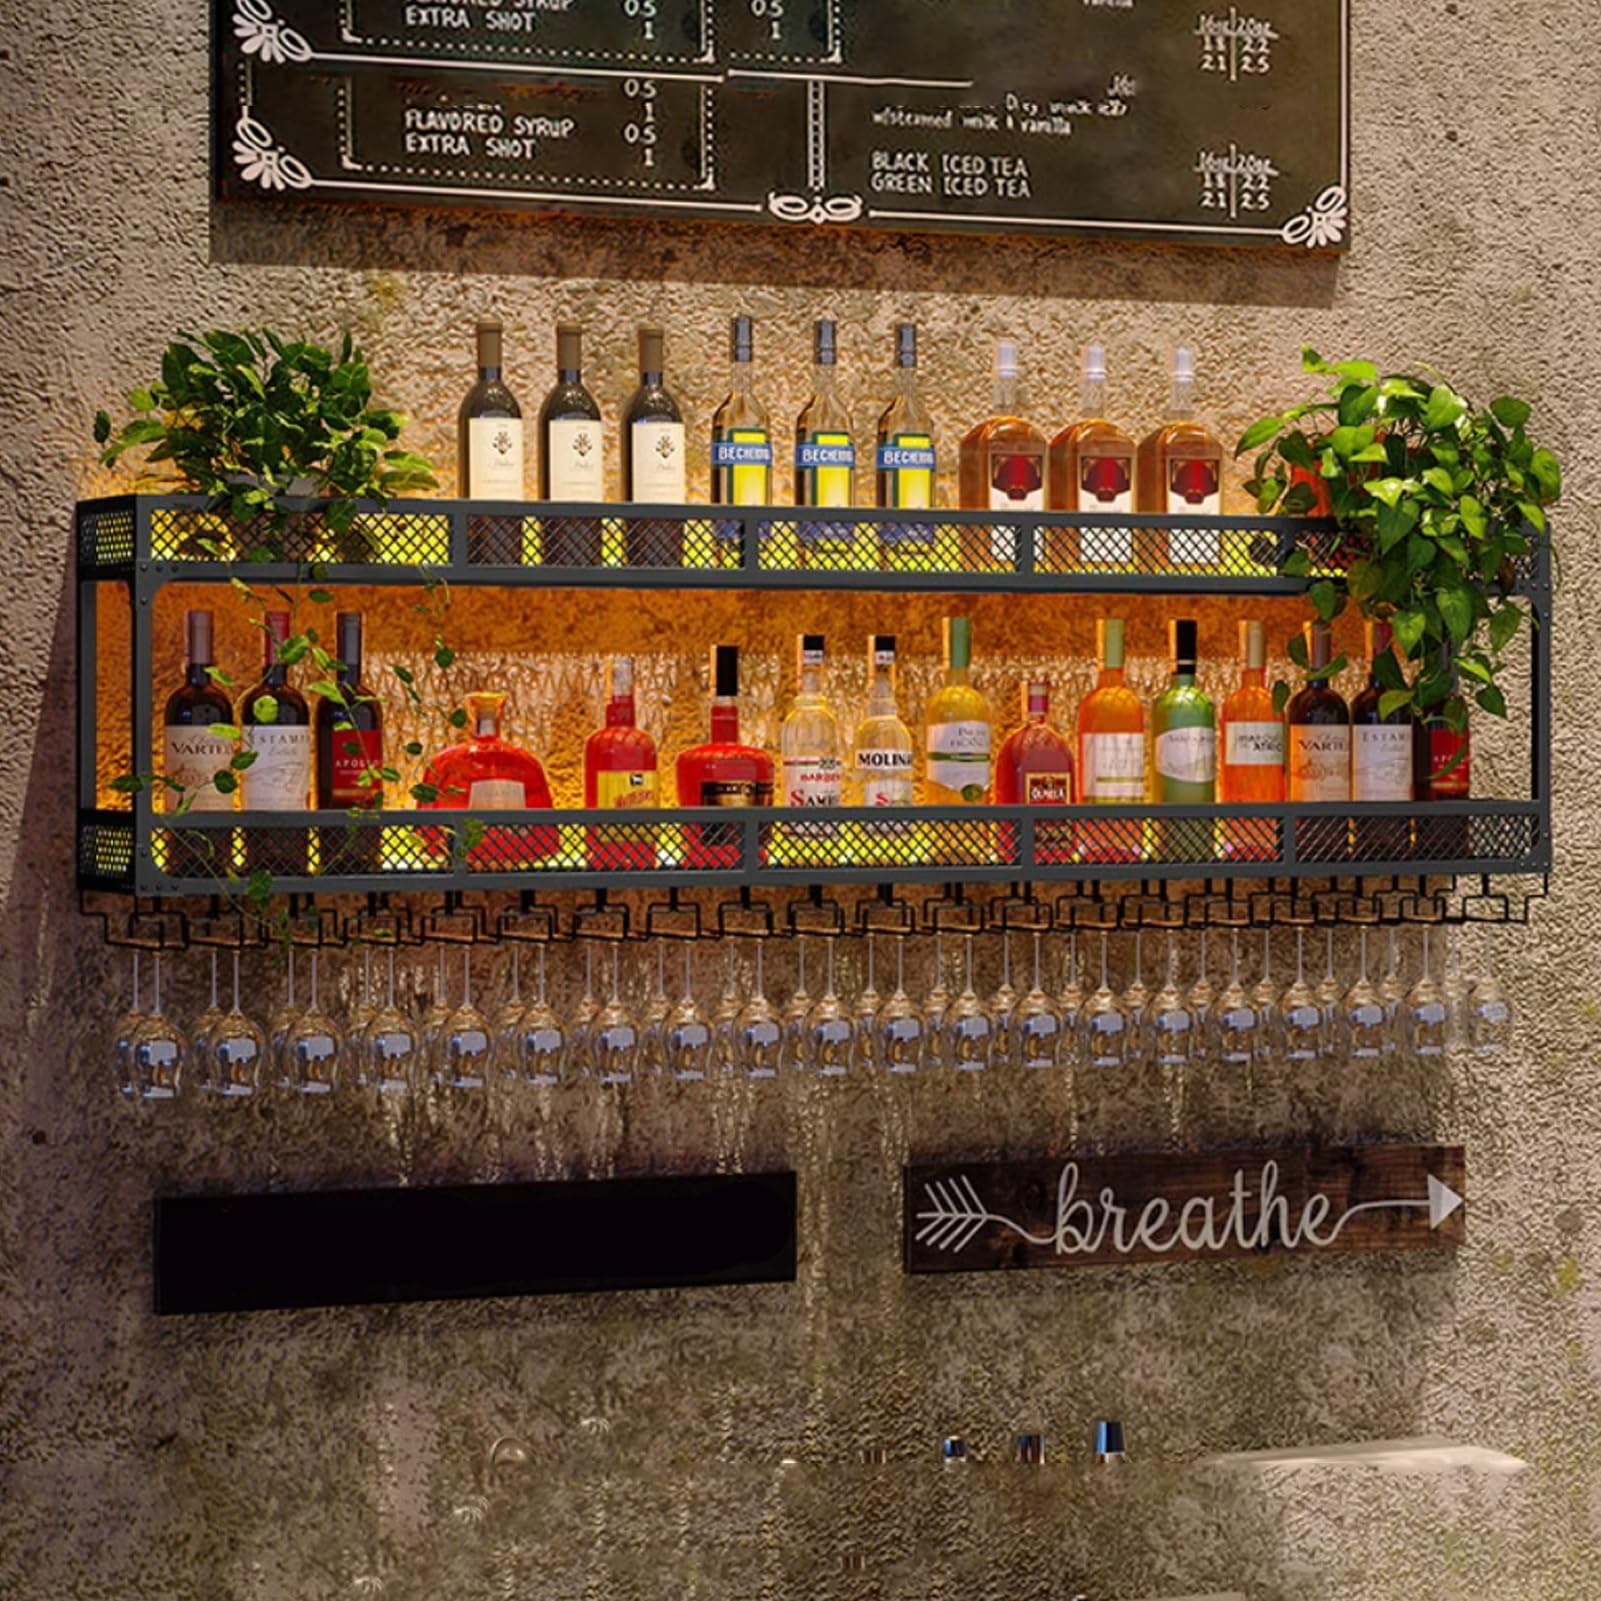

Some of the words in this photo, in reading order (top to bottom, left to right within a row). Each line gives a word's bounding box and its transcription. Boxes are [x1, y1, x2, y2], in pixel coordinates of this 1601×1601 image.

[405, 5, 470, 29] EXTRA
[485, 10, 537, 32] SHOT
[1201, 54, 1227, 71] 21
[405, 108, 504, 134] FLAVORED
[514, 115, 575, 137] SYRUP
[405, 132, 470, 156] EXTRA
[485, 137, 537, 159] SHOT
[871, 151, 929, 172] BLACK
[942, 153, 986, 176] ICED
[991, 157, 1029, 178] TEA
[871, 172, 933, 194] GREEN
[943, 176, 988, 197] ICED
[995, 178, 1031, 199] TEA
[1201, 191, 1227, 208] 21
[1056, 1160, 1336, 1255] breathe
